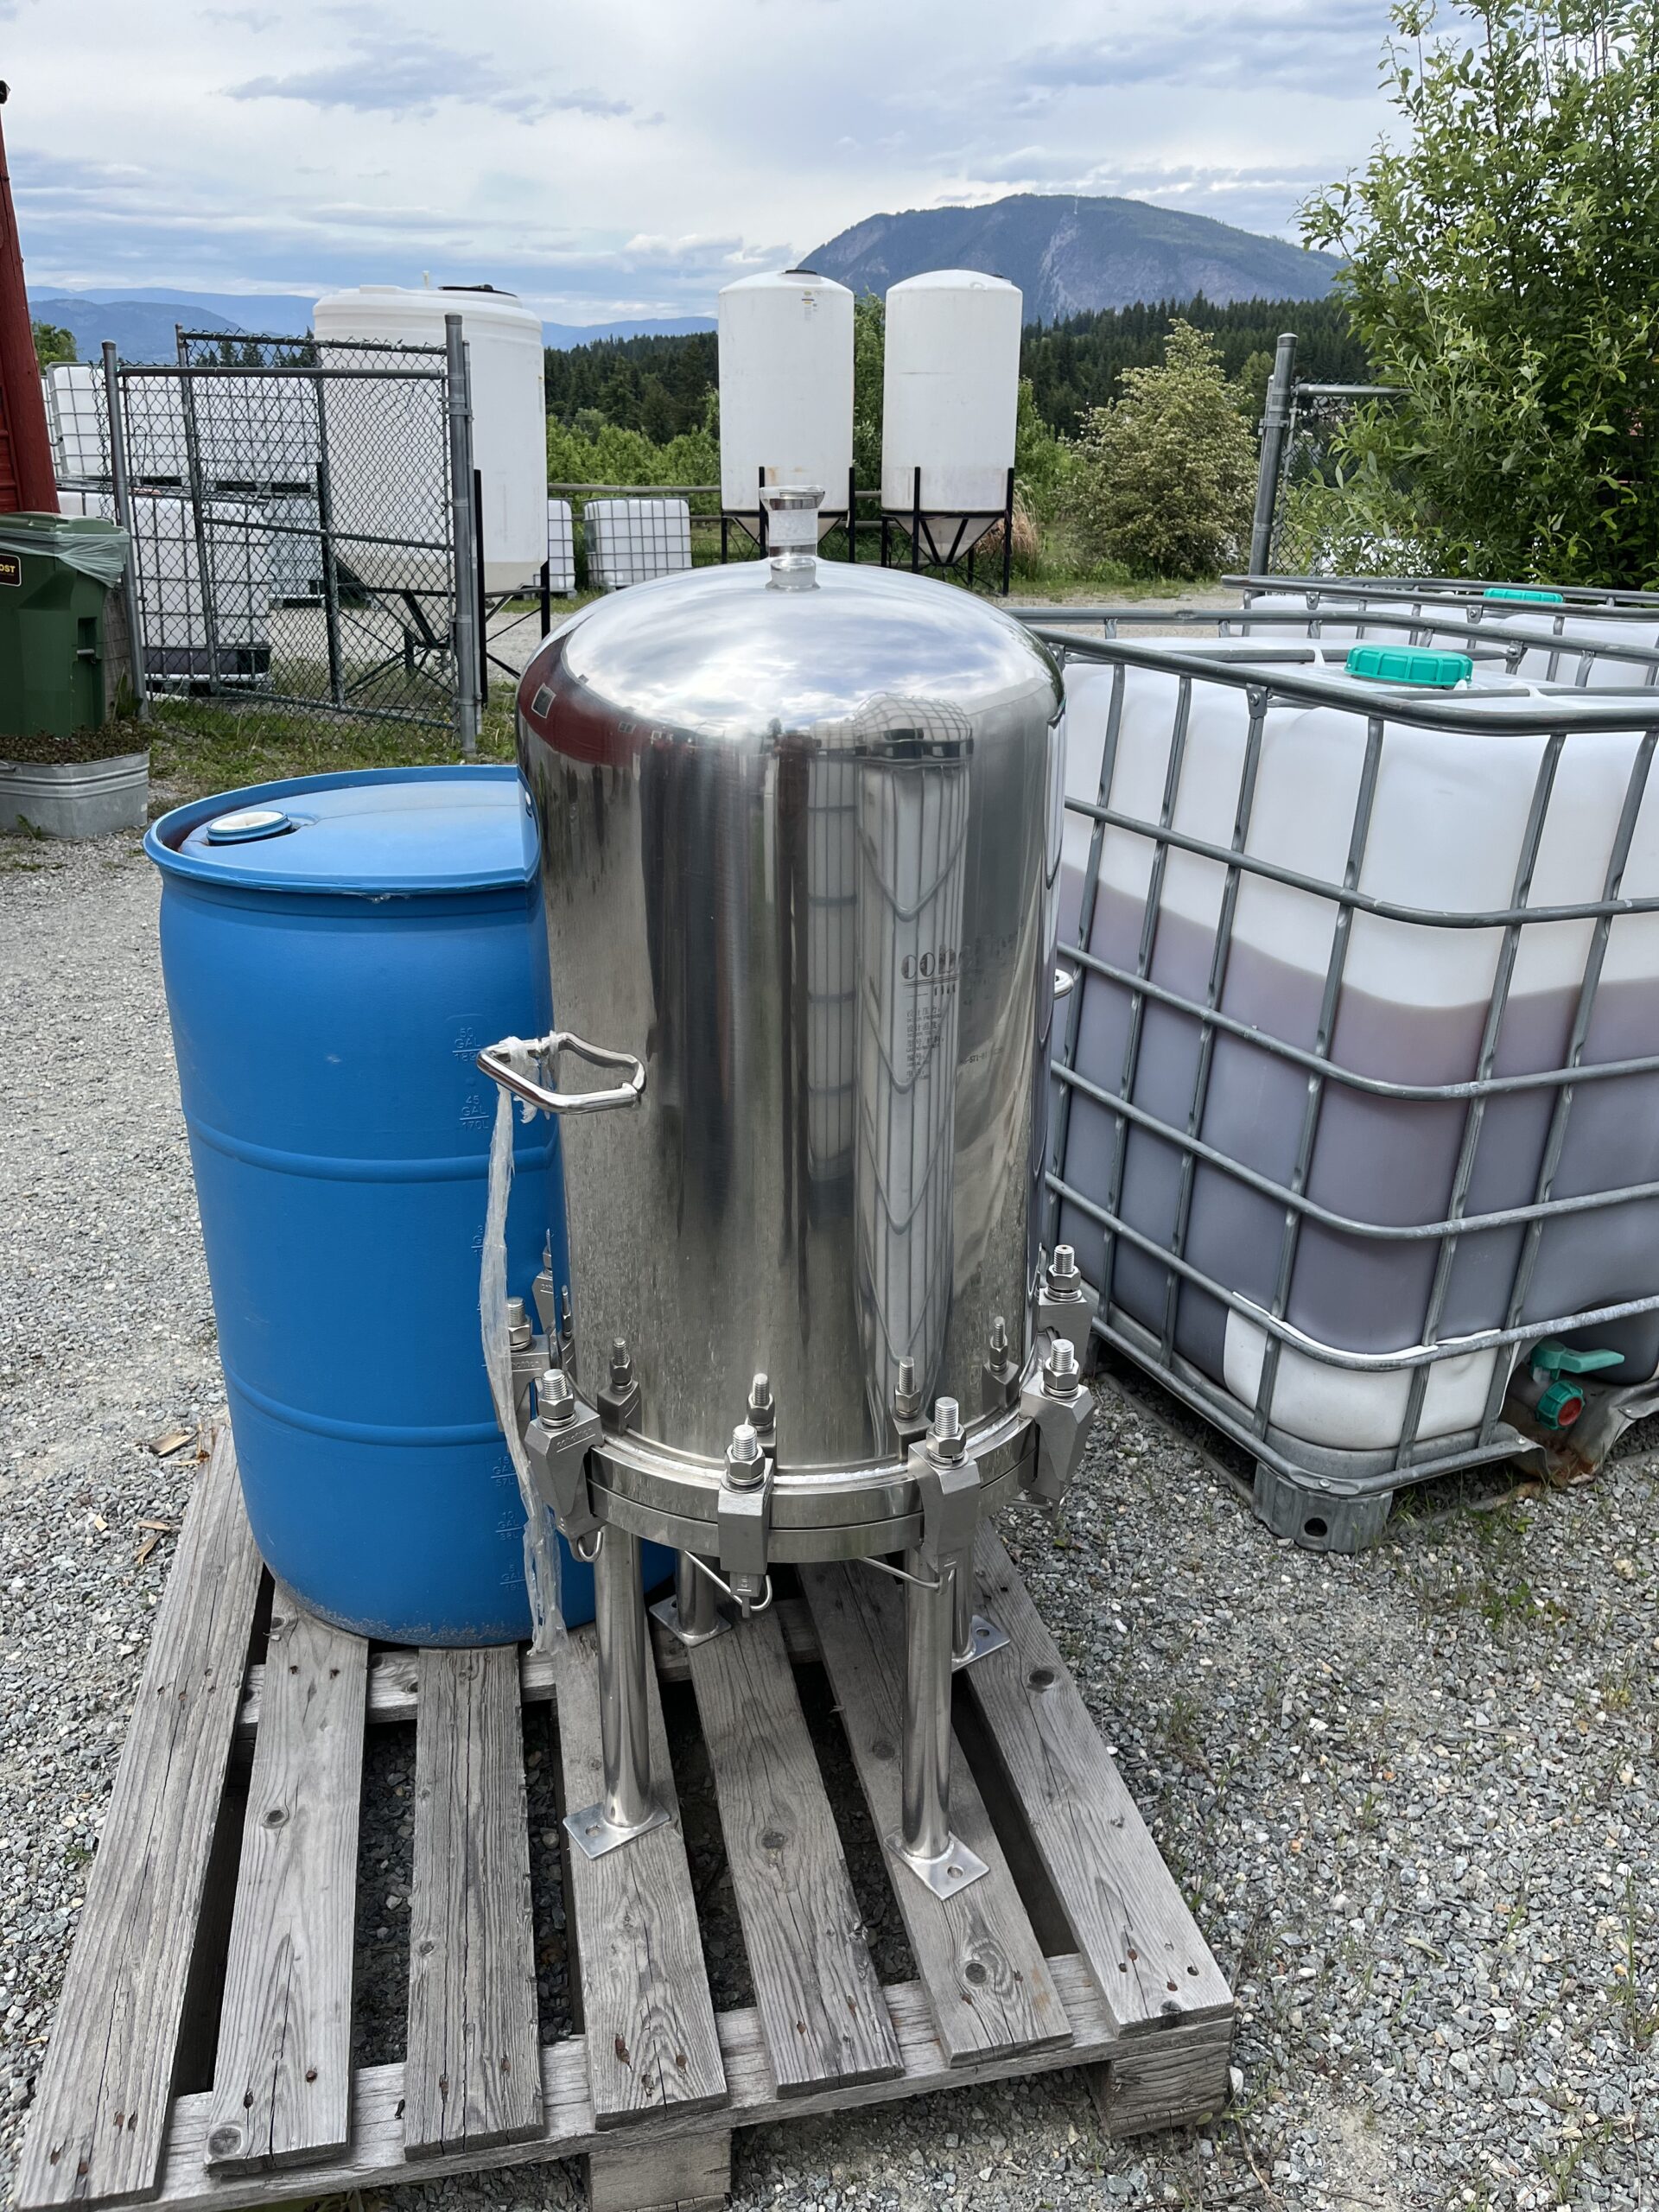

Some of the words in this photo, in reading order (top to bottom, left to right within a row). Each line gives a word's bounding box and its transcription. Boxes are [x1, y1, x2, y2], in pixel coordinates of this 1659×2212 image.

[460, 1027, 474, 1038] 50
[454, 1038, 481, 1049] GAL
[454, 1052, 477, 1062] 189
[466, 1095, 480, 1104] 45
[461, 1106, 486, 1116] GAL
[462, 1120, 489, 1130] 170L
[498, 1456, 509, 1465] 15
[493, 1465, 516, 1475] GAL
[495, 1478, 515, 1487] 57L
[498, 1519, 520, 1529] GAL
[501, 1573, 524, 1581] GAL
